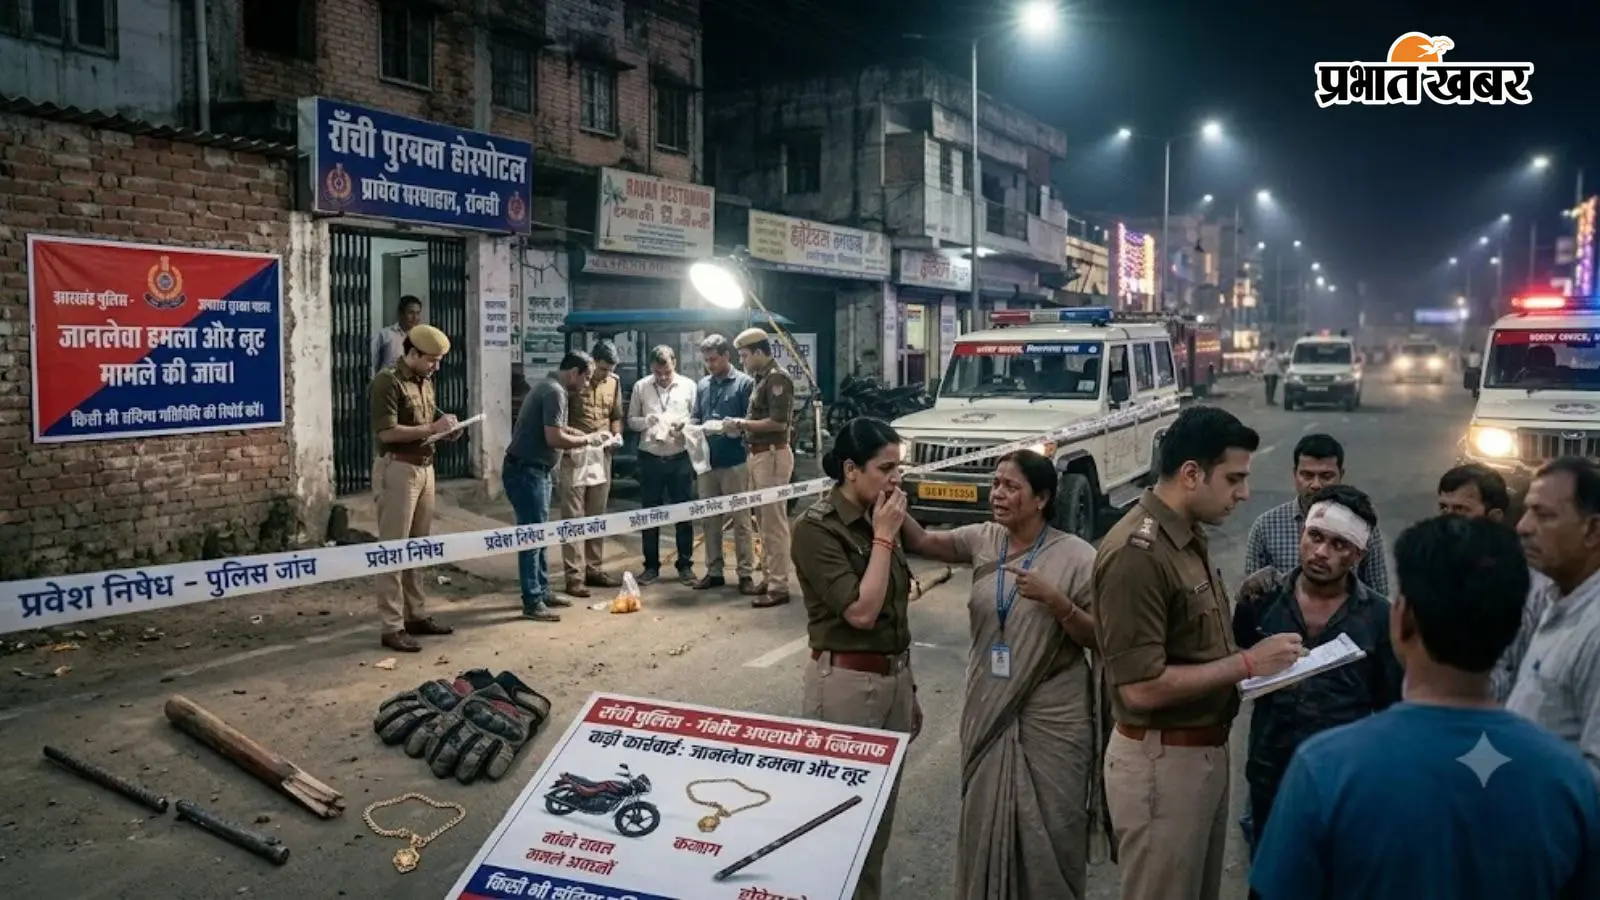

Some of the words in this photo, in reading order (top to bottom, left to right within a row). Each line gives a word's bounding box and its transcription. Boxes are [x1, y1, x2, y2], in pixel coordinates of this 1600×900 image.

[57, 319, 142, 348] जानलेवा
[146, 326, 198, 349] हमला
[202, 320, 234, 348] और
[238, 327, 266, 356] लूट
[99, 357, 157, 387] मामले
[161, 357, 187, 386] की
[71, 409, 102, 427] किसी
[105, 408, 118, 426] भी
[203, 404, 216, 420] की
[365, 546, 403, 568] प्रवेश
[407, 540, 444, 563] निषेध
[18, 582, 95, 618] प्रवेश
[102, 571, 175, 606] निषेध
[205, 561, 268, 597] पुलिस
[274, 554, 317, 581] जांच
[598, 703, 635, 722] रांची
[632, 709, 684, 729] पुलिस
[696, 716, 742, 737] गंभीर
[742, 725, 807, 746] अपराधों
[805, 731, 824, 749] के
[688, 744, 753, 767] जानलेवा
[806, 760, 840, 779] और
[841, 767, 871, 786] लूट
